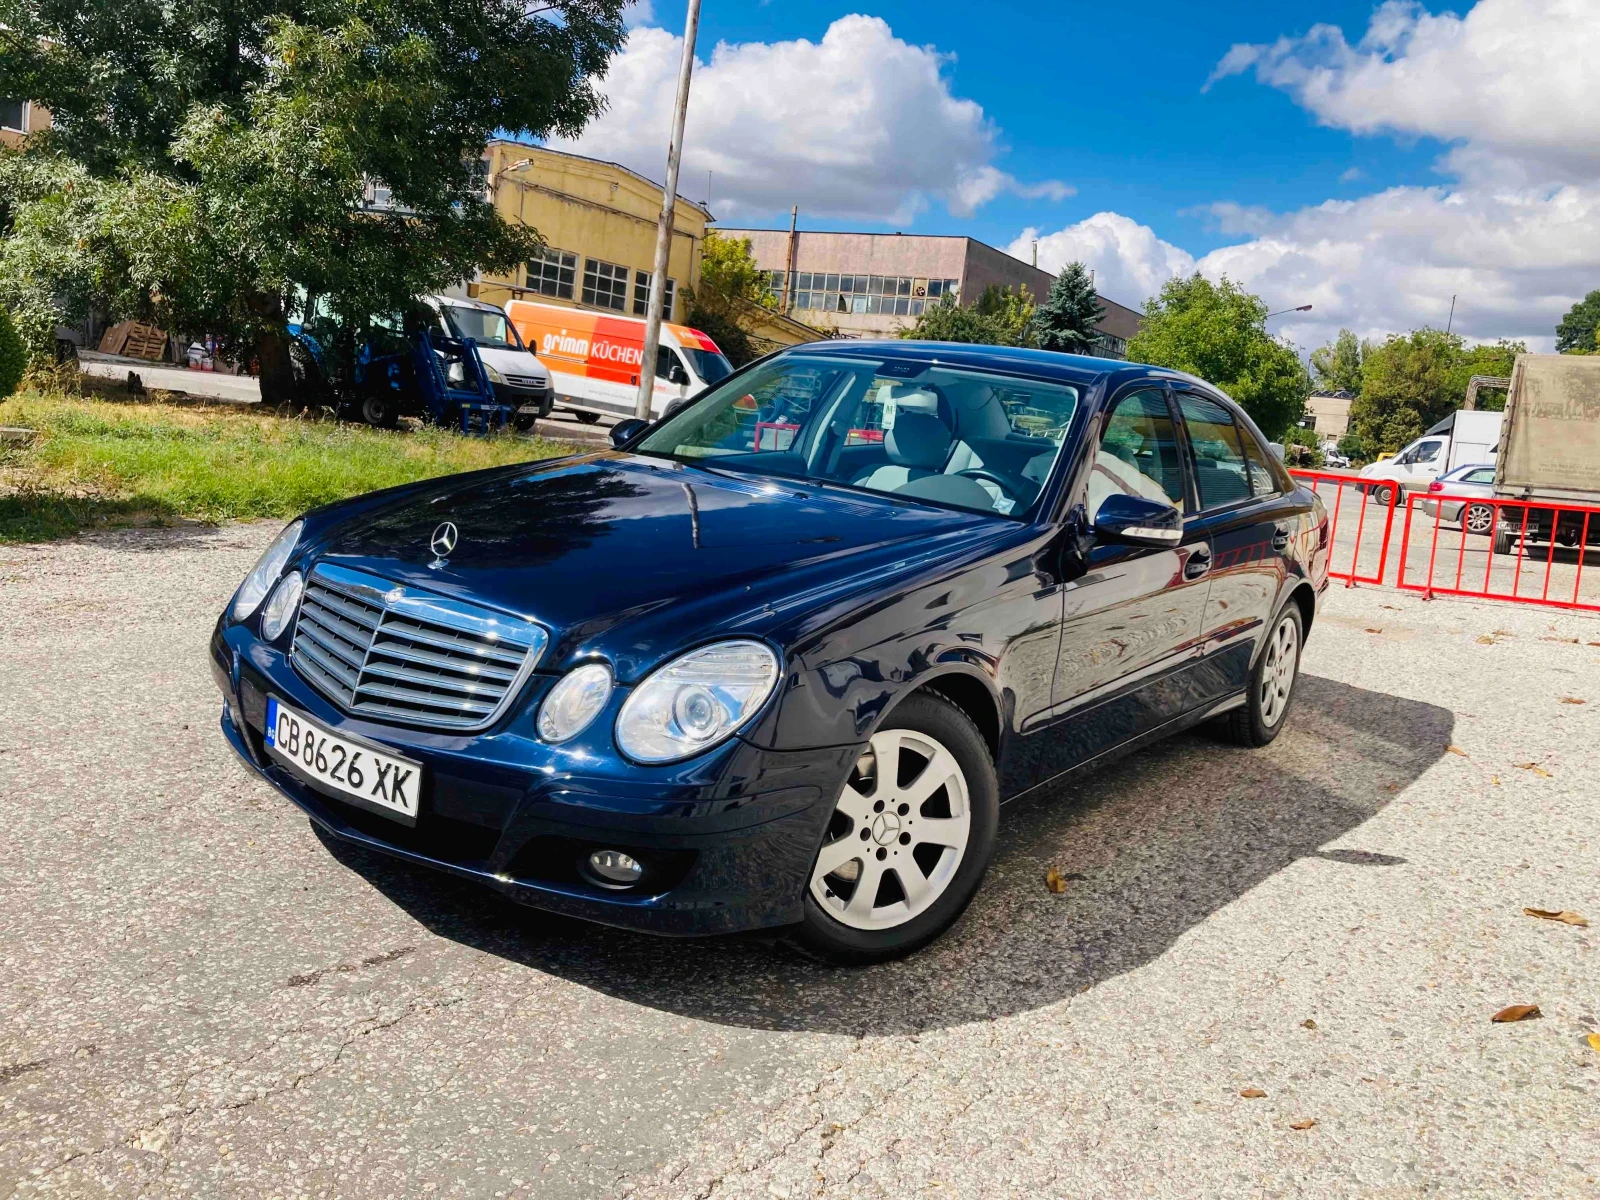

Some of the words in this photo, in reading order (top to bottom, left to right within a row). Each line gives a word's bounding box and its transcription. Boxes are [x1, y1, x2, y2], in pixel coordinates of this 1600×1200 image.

[542, 328, 589, 355] grimm
[590, 340, 644, 366] KÜCHEN
[267, 726, 275, 740] BG
[371, 757, 413, 809] XK
